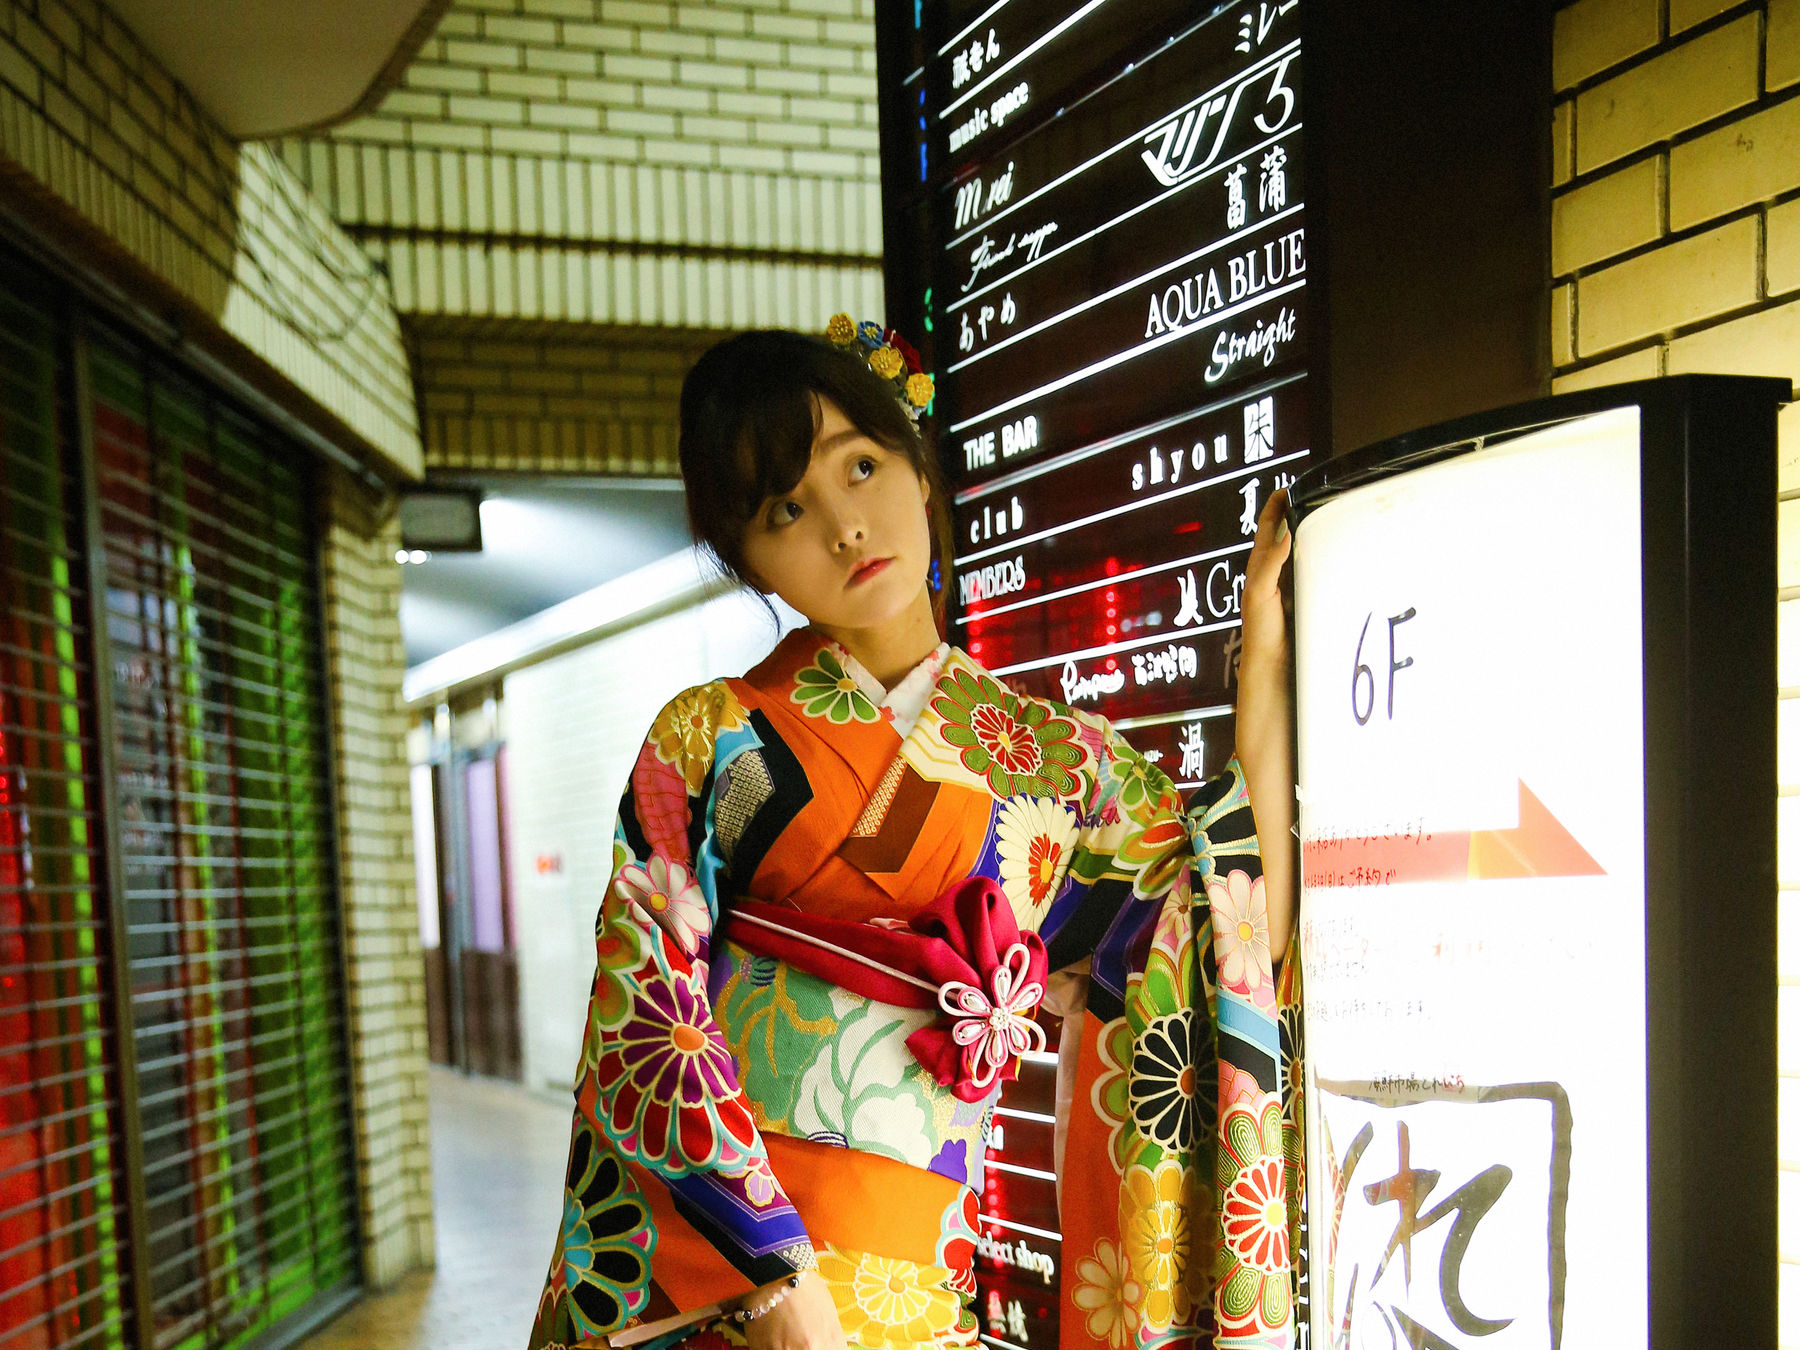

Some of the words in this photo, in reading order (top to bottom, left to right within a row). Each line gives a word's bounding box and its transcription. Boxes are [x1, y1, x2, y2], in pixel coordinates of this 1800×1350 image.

[1144, 267, 1224, 339] AQUA
[1227, 227, 1307, 304] BLUE
[959, 291, 1017, 353] あやめ
[1204, 306, 1296, 383] Straight
[963, 431, 996, 472] THE
[1001, 415, 1038, 458] BAR
[970, 496, 1024, 544] club
[1351, 606, 1418, 727] 6F
